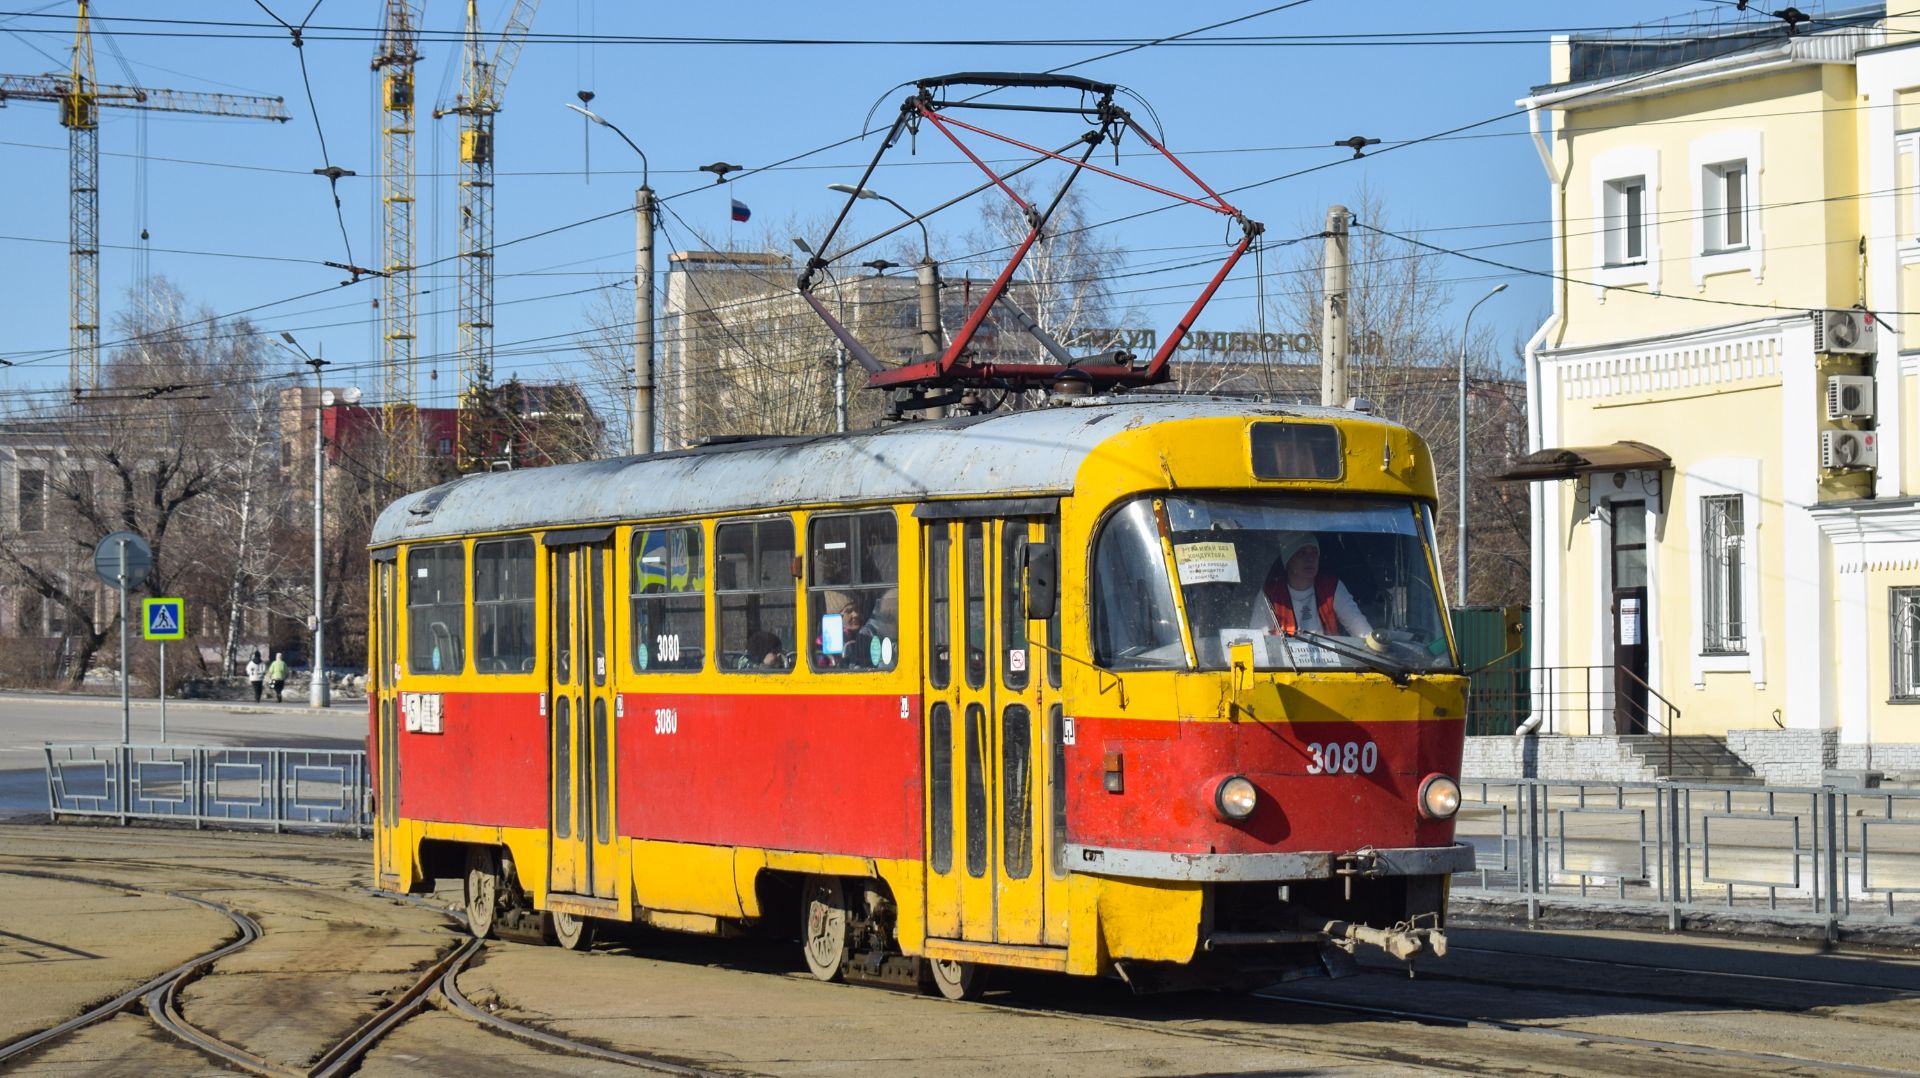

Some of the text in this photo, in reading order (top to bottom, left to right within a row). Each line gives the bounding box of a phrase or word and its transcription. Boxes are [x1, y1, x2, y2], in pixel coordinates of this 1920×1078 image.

[657, 634, 680, 662] 3080
[655, 708, 677, 734] 3080
[1306, 741, 1378, 775] 3080
